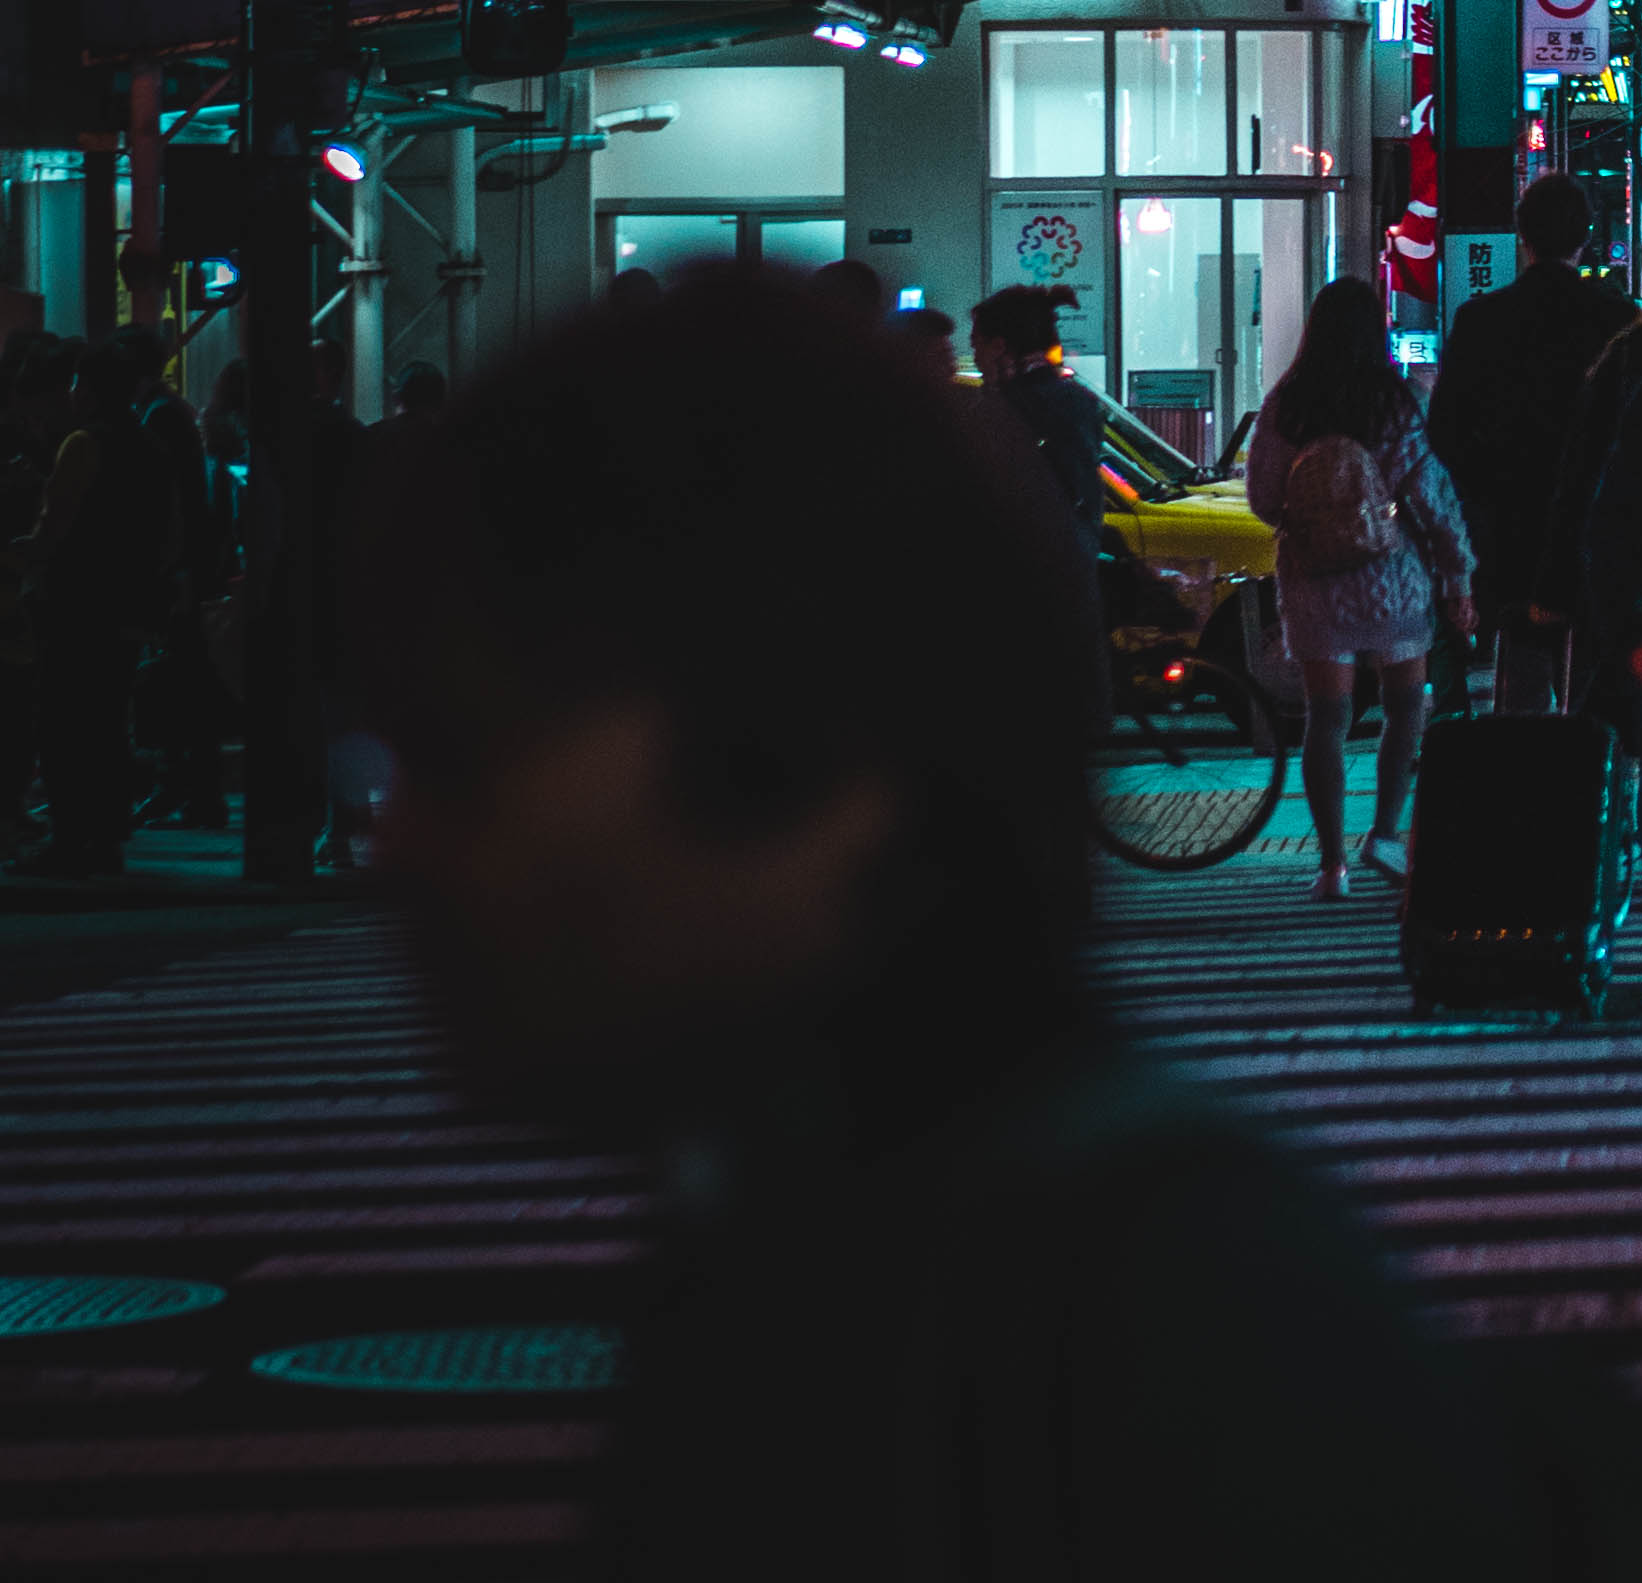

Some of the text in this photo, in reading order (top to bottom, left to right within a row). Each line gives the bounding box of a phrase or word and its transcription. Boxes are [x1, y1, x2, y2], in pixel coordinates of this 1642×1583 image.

[1547, 30, 1585, 46] 区域
[1535, 47, 1597, 62] ここから
[1469, 243, 1491, 296] 防犯
